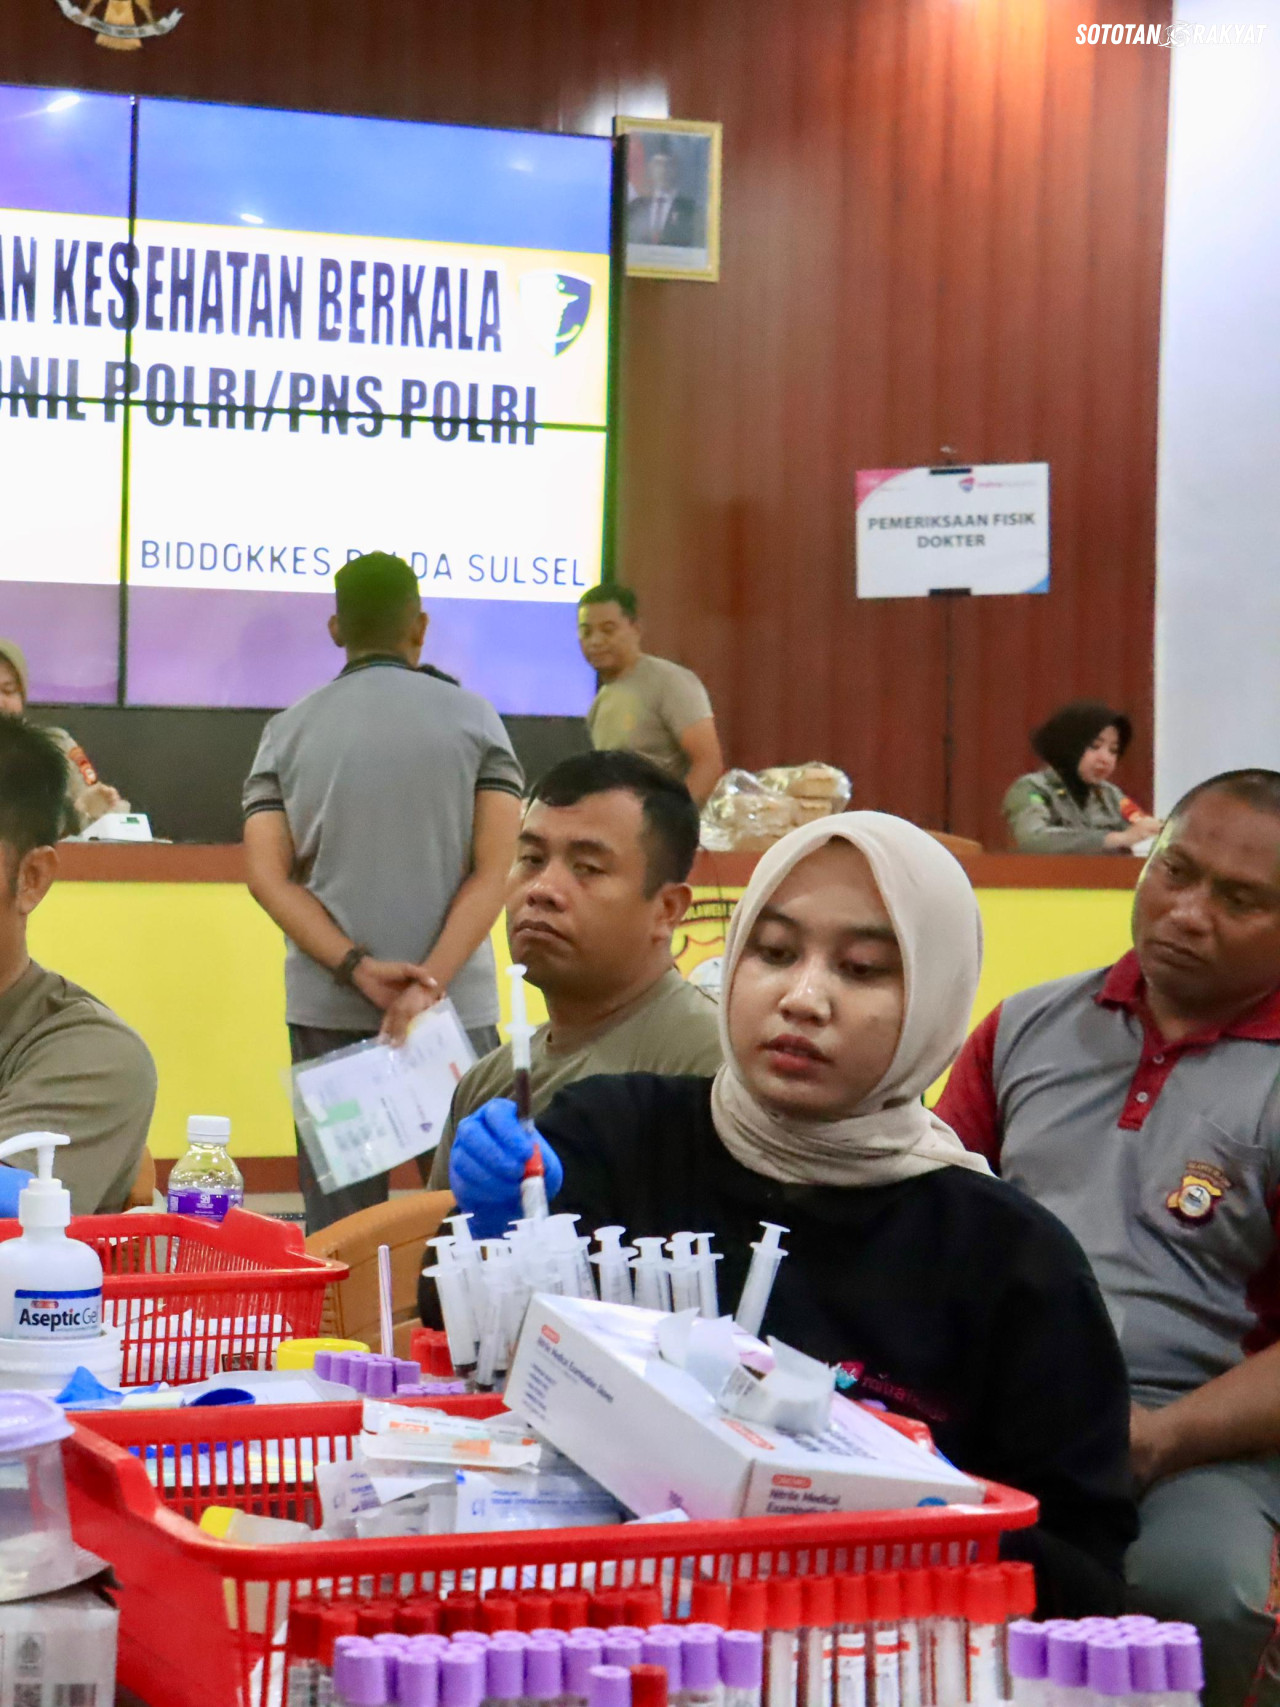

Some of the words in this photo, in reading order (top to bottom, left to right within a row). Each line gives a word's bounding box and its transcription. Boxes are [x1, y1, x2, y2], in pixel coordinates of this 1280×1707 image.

[53, 238, 304, 340] KESEHATAN
[319, 257, 503, 353] BERKALA
[104, 360, 383, 438] POLRI/PNS
[400, 378, 537, 446] POLRI
[868, 514, 989, 531] PEMERIKSAAN
[992, 512, 1036, 526] FISIK
[916, 533, 986, 549] DOKTER
[140, 539, 331, 576] BIDDOKKES
[467, 553, 587, 587] SULSEL
[18, 1307, 81, 1332] Aseptic
